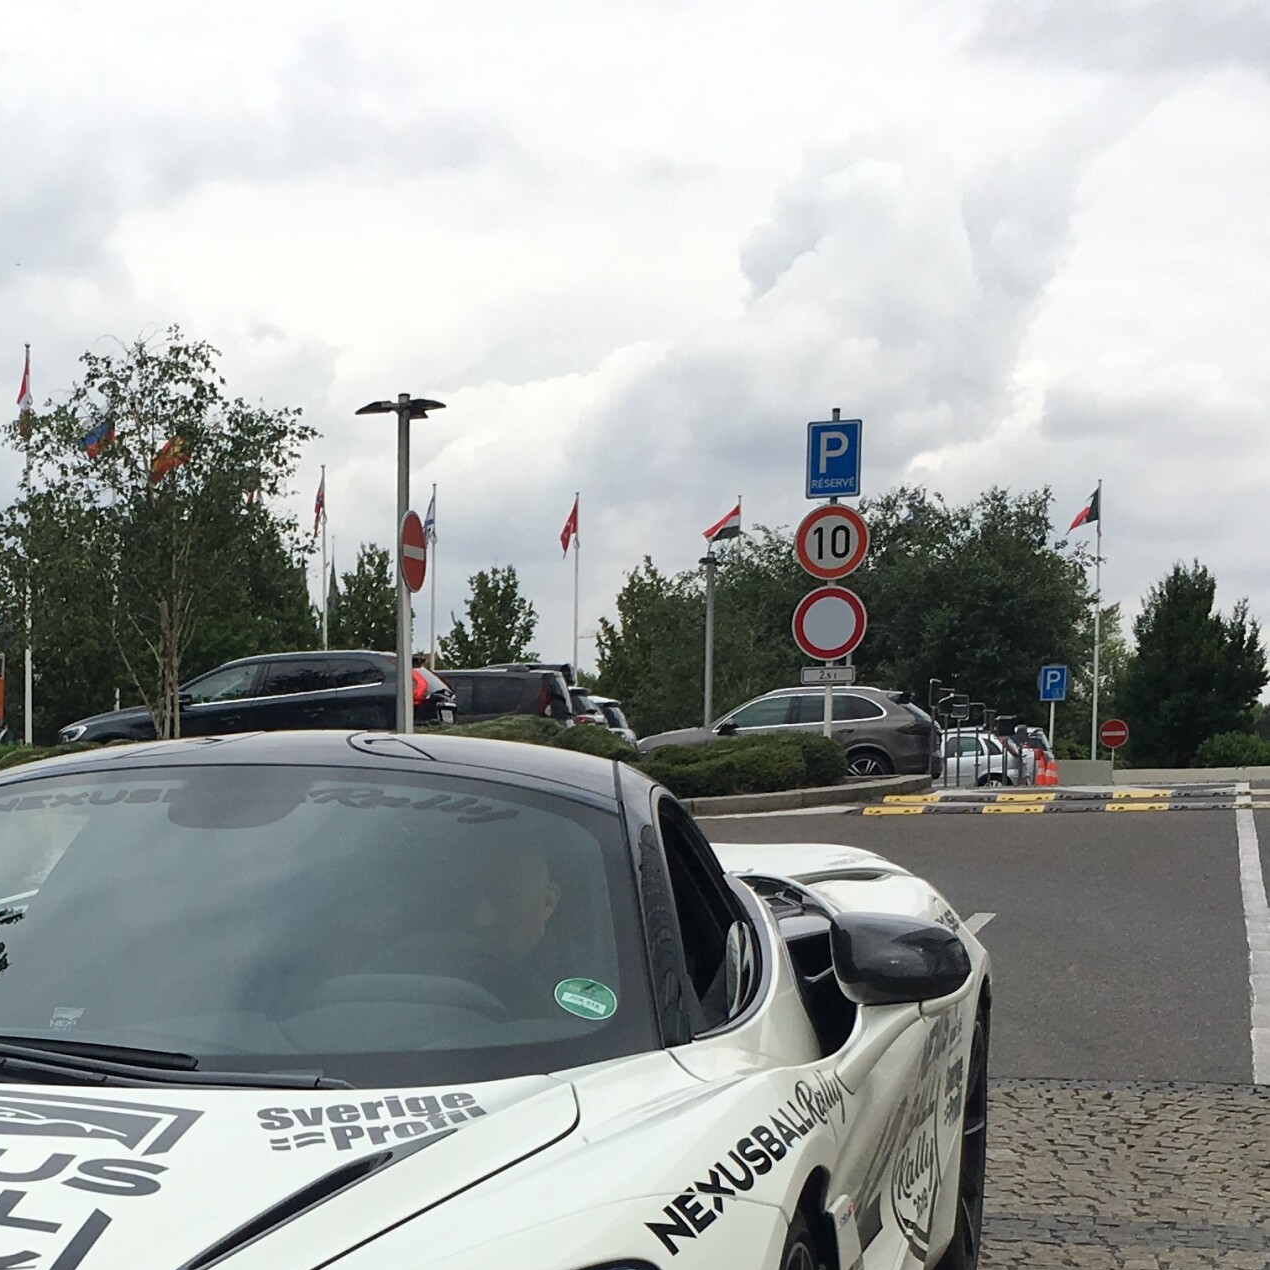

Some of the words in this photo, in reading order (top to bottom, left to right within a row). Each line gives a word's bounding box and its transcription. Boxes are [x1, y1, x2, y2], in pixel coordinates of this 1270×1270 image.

[819, 431, 849, 474] P
[813, 525, 850, 560] 10
[1046, 671, 1061, 690] P
[257, 1092, 476, 1130] Sverige
